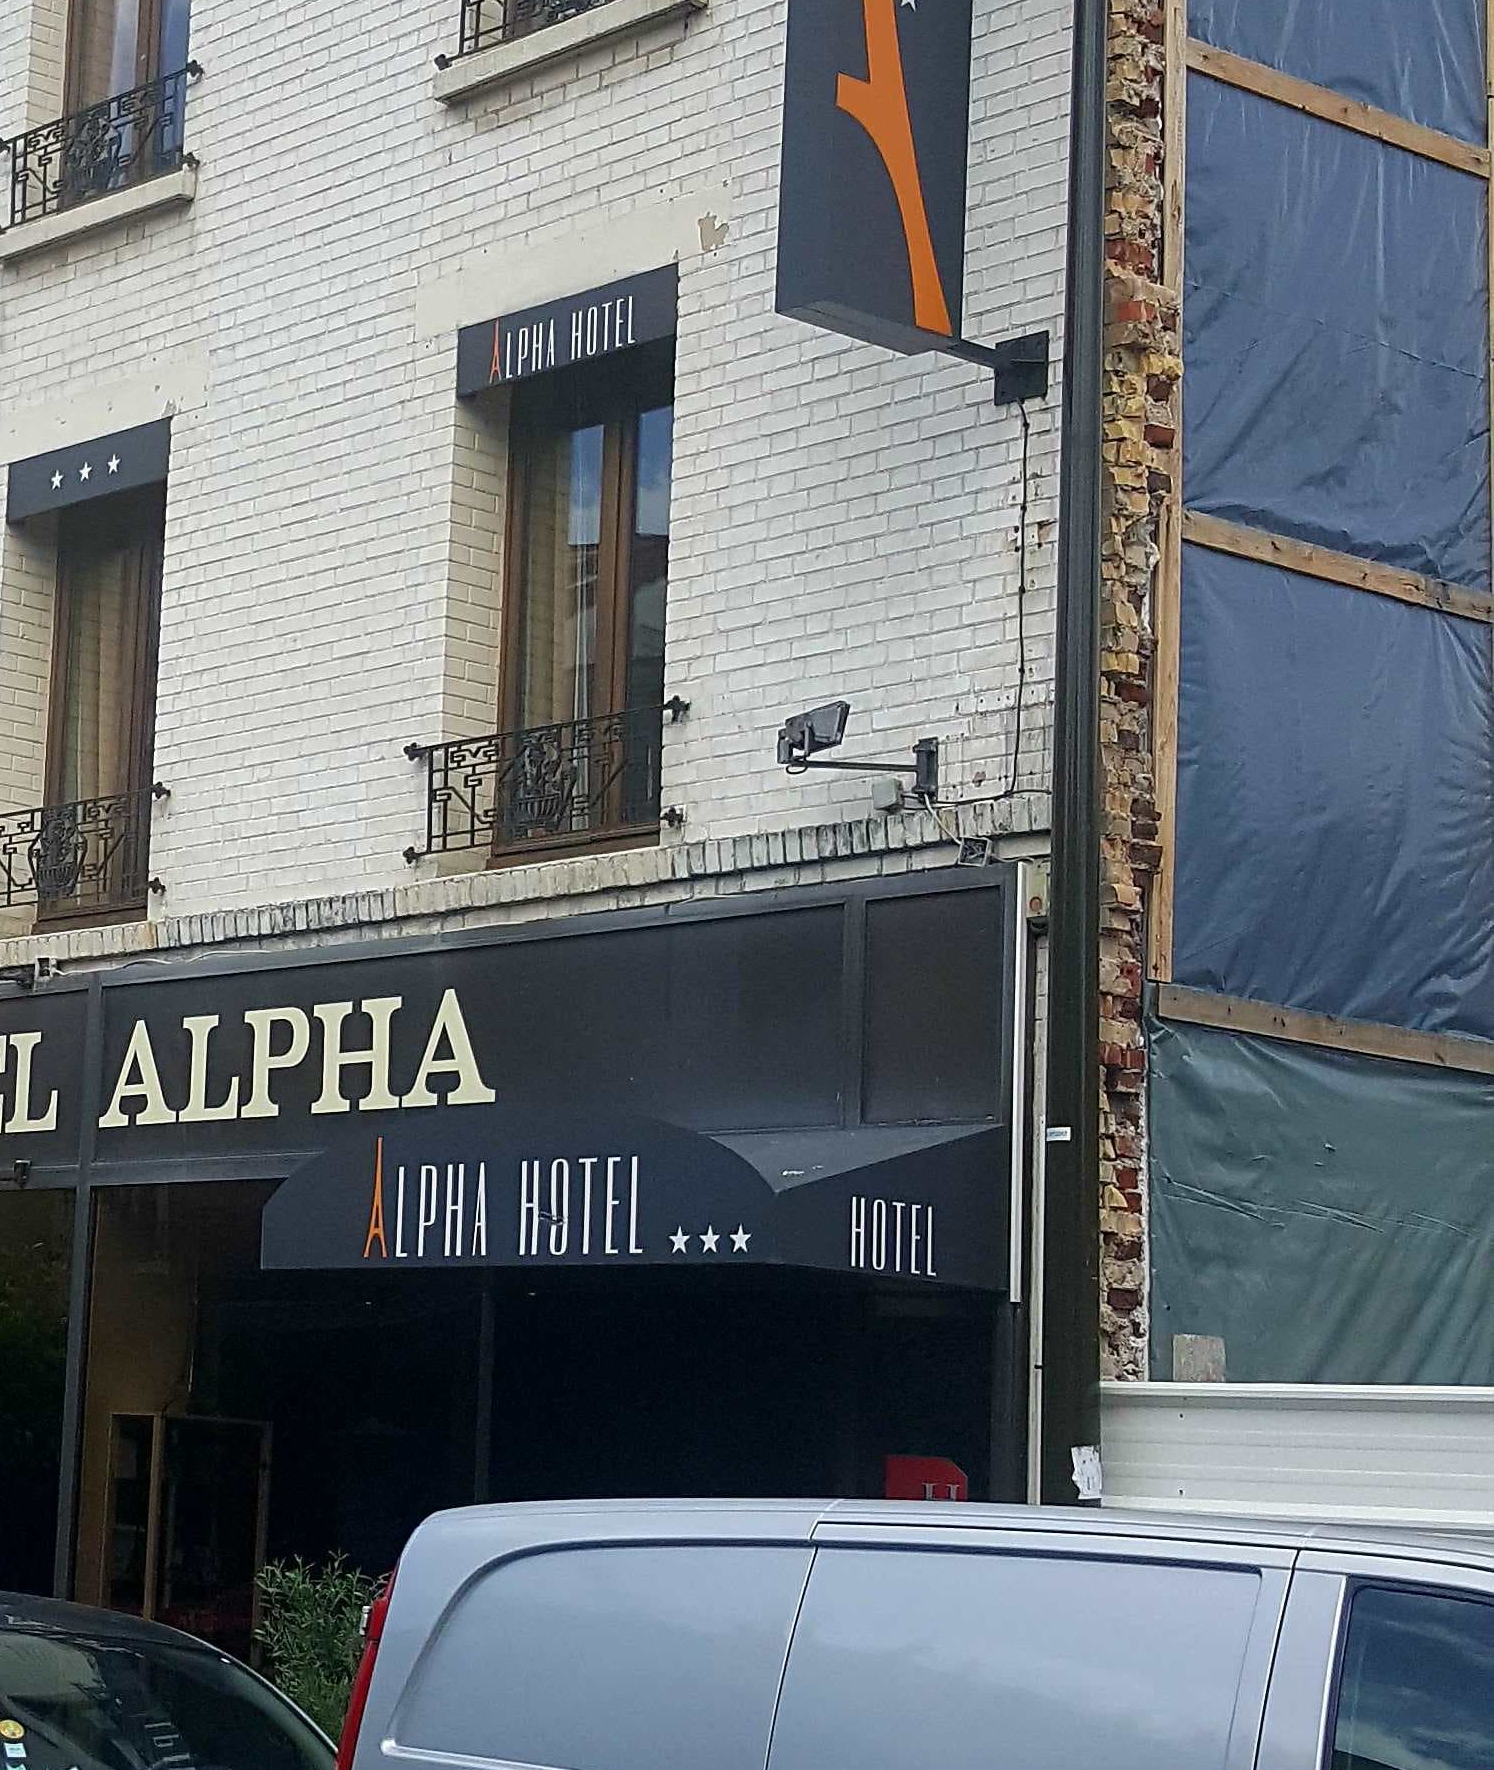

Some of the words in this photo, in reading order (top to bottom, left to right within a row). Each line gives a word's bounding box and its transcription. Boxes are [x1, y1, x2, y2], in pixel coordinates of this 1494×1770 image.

[489, 317, 556, 384] ALPHA
[570, 295, 636, 360] HOTEL
[97, 987, 497, 1128] ALPHA
[362, 1135, 487, 1258] ALPHA
[519, 1155, 644, 1256] HOTEL
[850, 1195, 938, 1277] HOTEL
